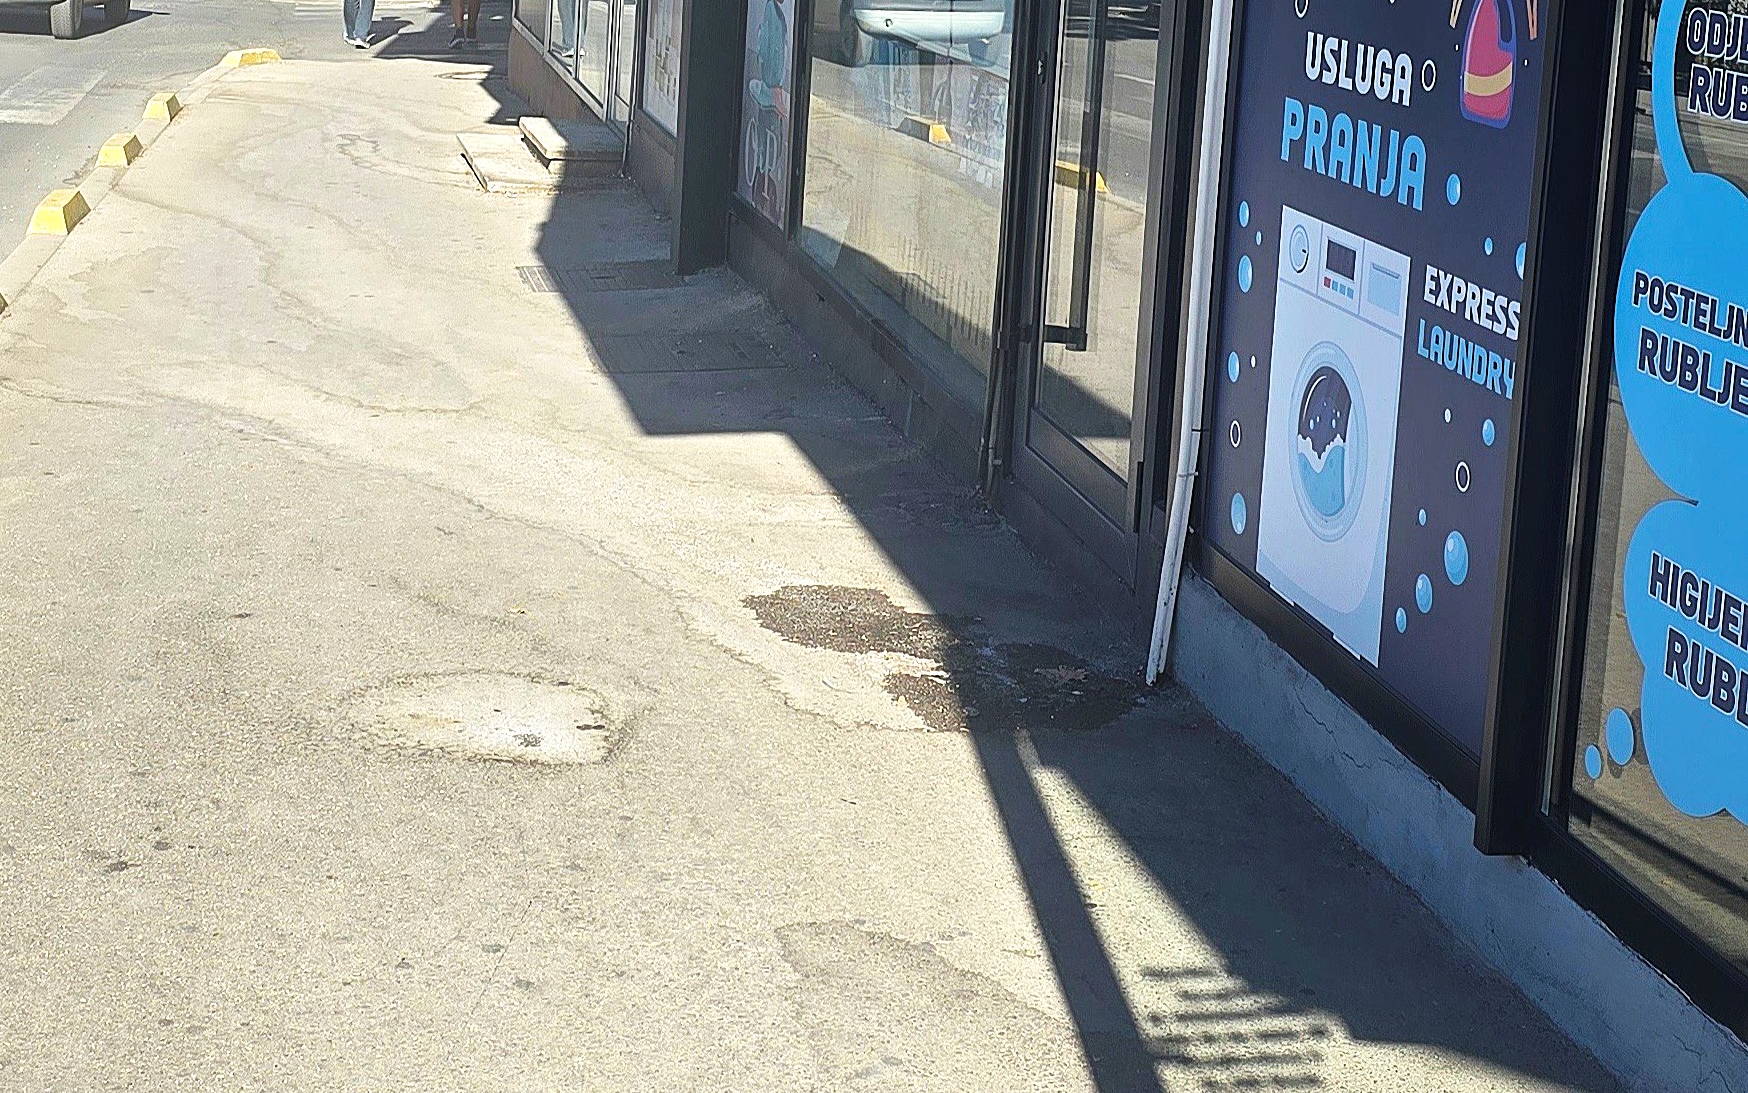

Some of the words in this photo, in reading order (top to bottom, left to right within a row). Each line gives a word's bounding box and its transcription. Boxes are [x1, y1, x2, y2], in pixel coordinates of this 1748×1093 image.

[1305, 31, 1413, 107] USLUGA
[1280, 96, 1427, 211] PRANJA
[1423, 264, 1521, 341] EXPRESS
[1417, 319, 1516, 400] LAUNDRY
[1637, 325, 1748, 418] RUBLJE
